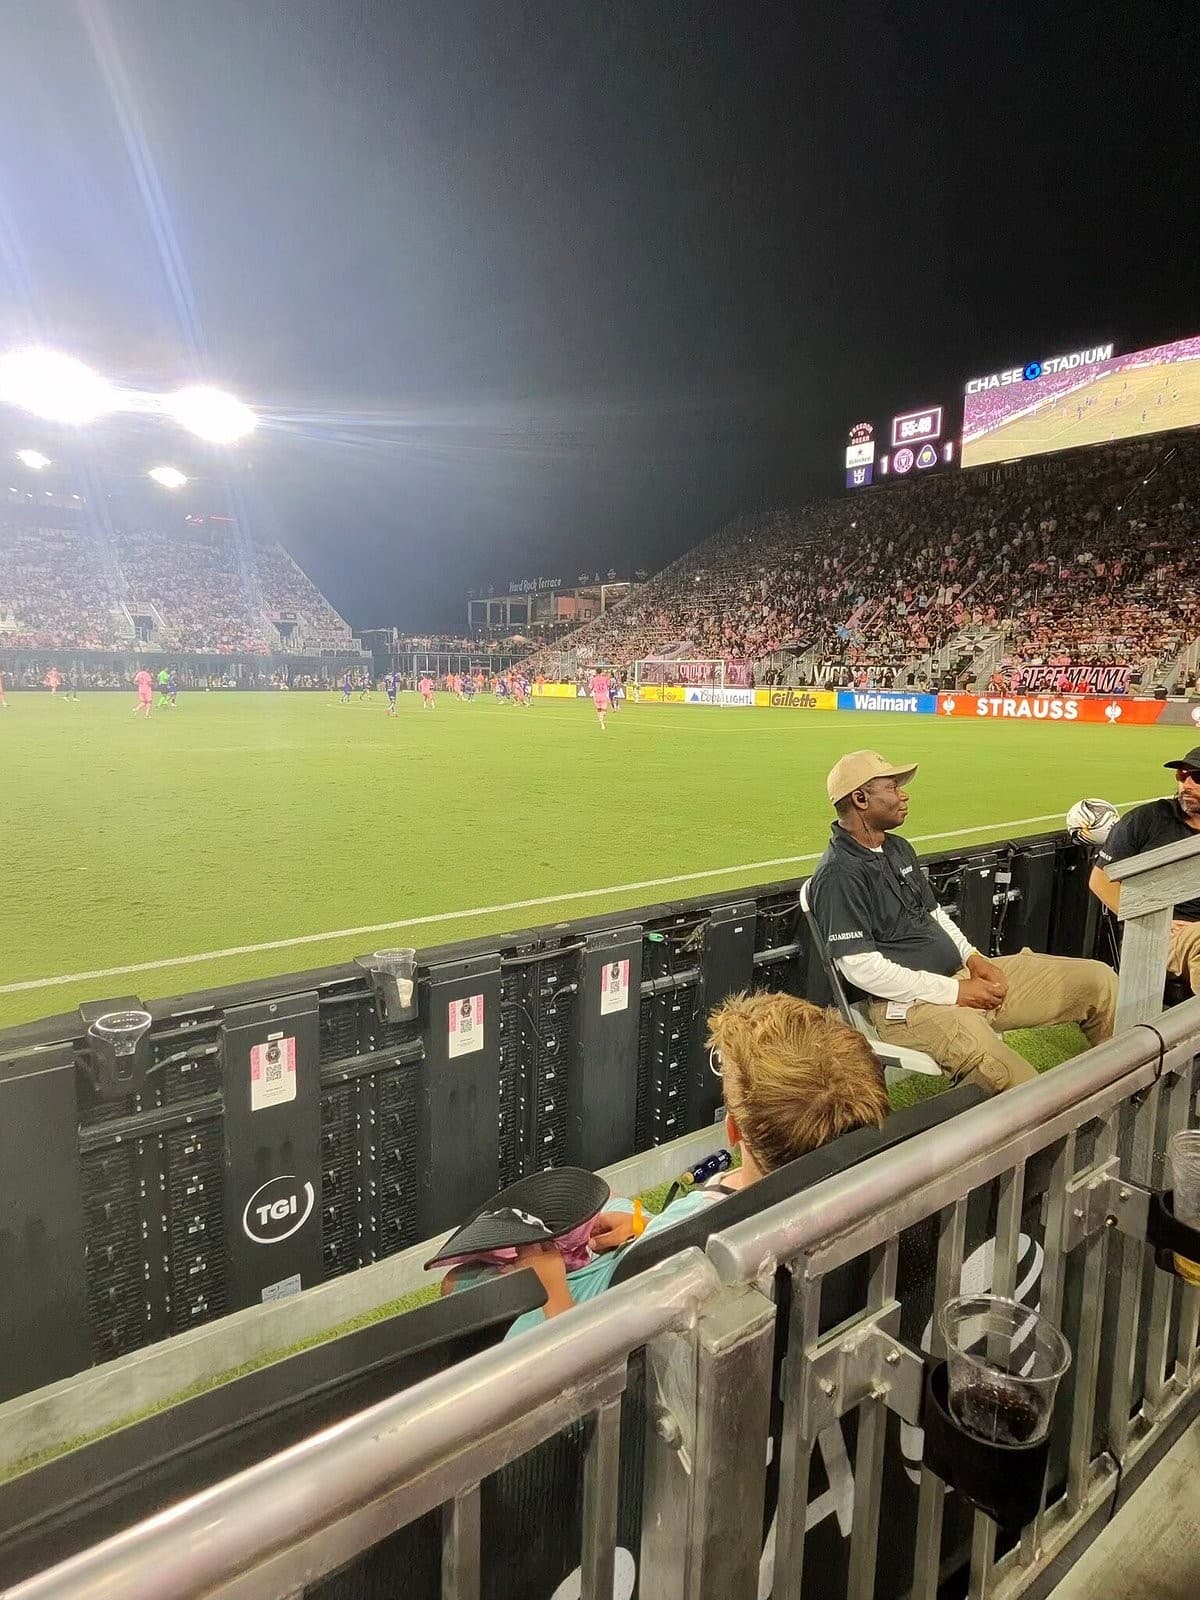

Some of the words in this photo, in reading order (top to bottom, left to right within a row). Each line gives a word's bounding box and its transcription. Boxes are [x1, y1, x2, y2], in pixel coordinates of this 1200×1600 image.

[967, 367, 1023, 394] CHASE
[1043, 343, 1113, 375] STADIUM
[945, 442, 953, 462] 1
[881, 455, 888, 474] 1
[523, 579, 537, 592] Rock
[538, 576, 562, 589] Terrace
[725, 695, 750, 704] LIGHT
[771, 691, 817, 708] Gillette
[854, 694, 918, 712] Walmart
[976, 698, 1079, 720] STRAUSS
[828, 931, 863, 941] GUARDIAN
[256, 1195, 297, 1226] TGI
